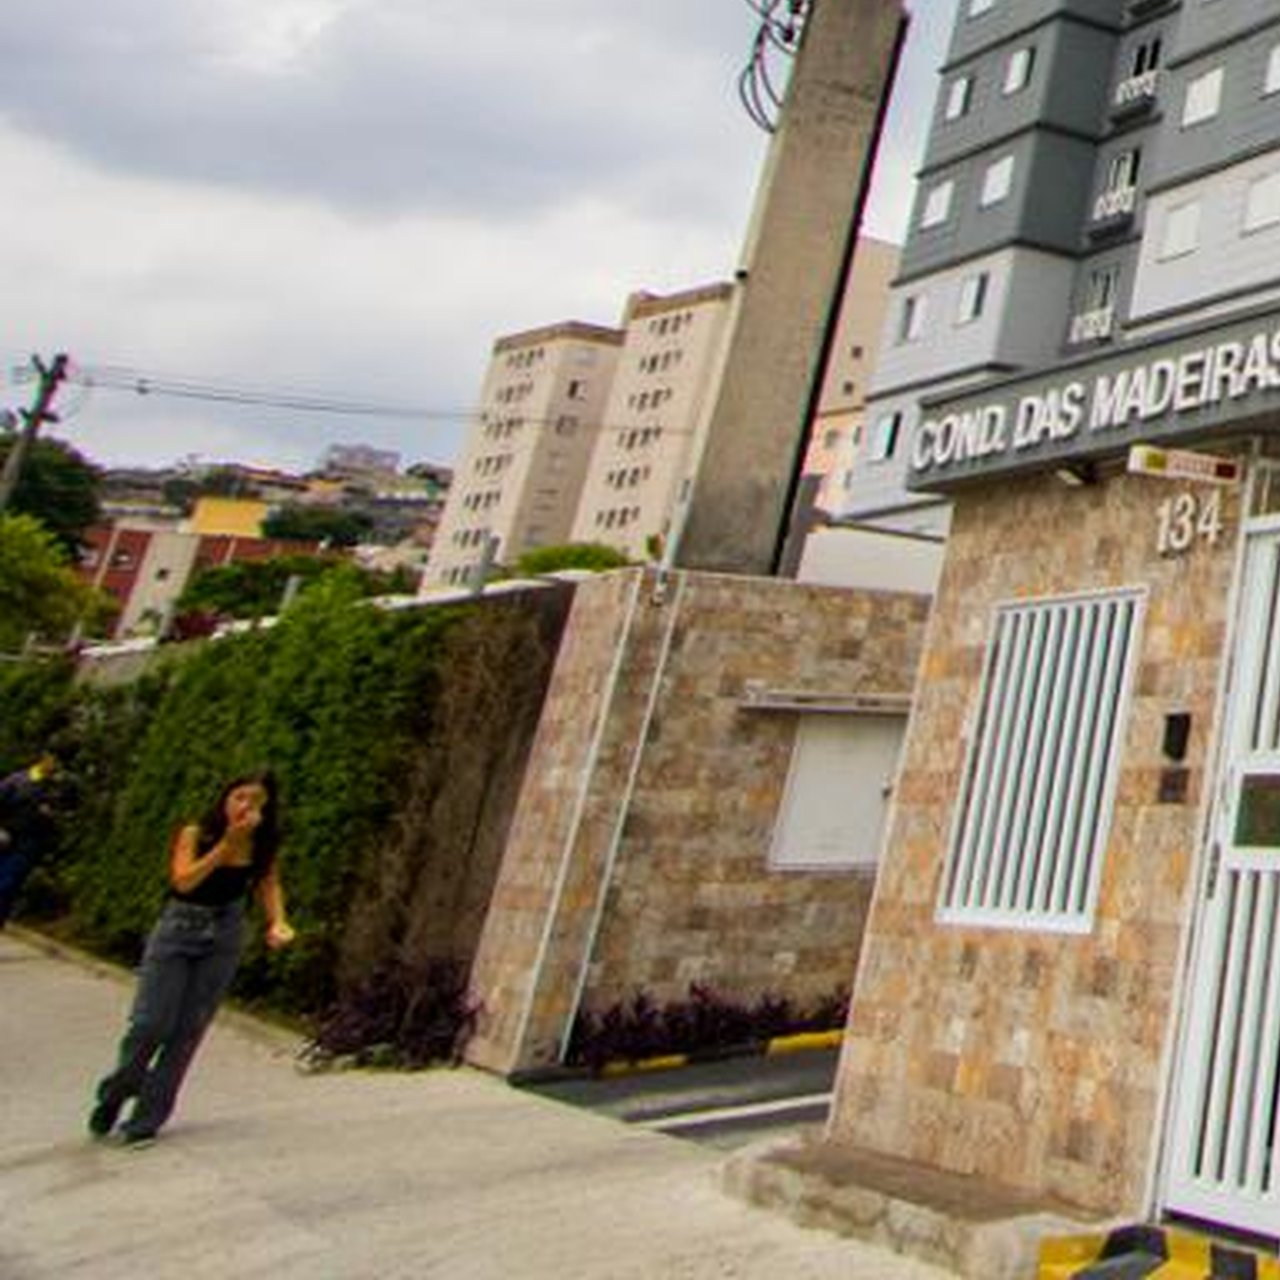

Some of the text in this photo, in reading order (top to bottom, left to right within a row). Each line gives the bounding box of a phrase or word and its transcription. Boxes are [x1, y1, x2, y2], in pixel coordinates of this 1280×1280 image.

[912, 404, 1006, 470] COND.
[1013, 383, 1085, 448] DAS
[1157, 490, 1223, 552] 134
